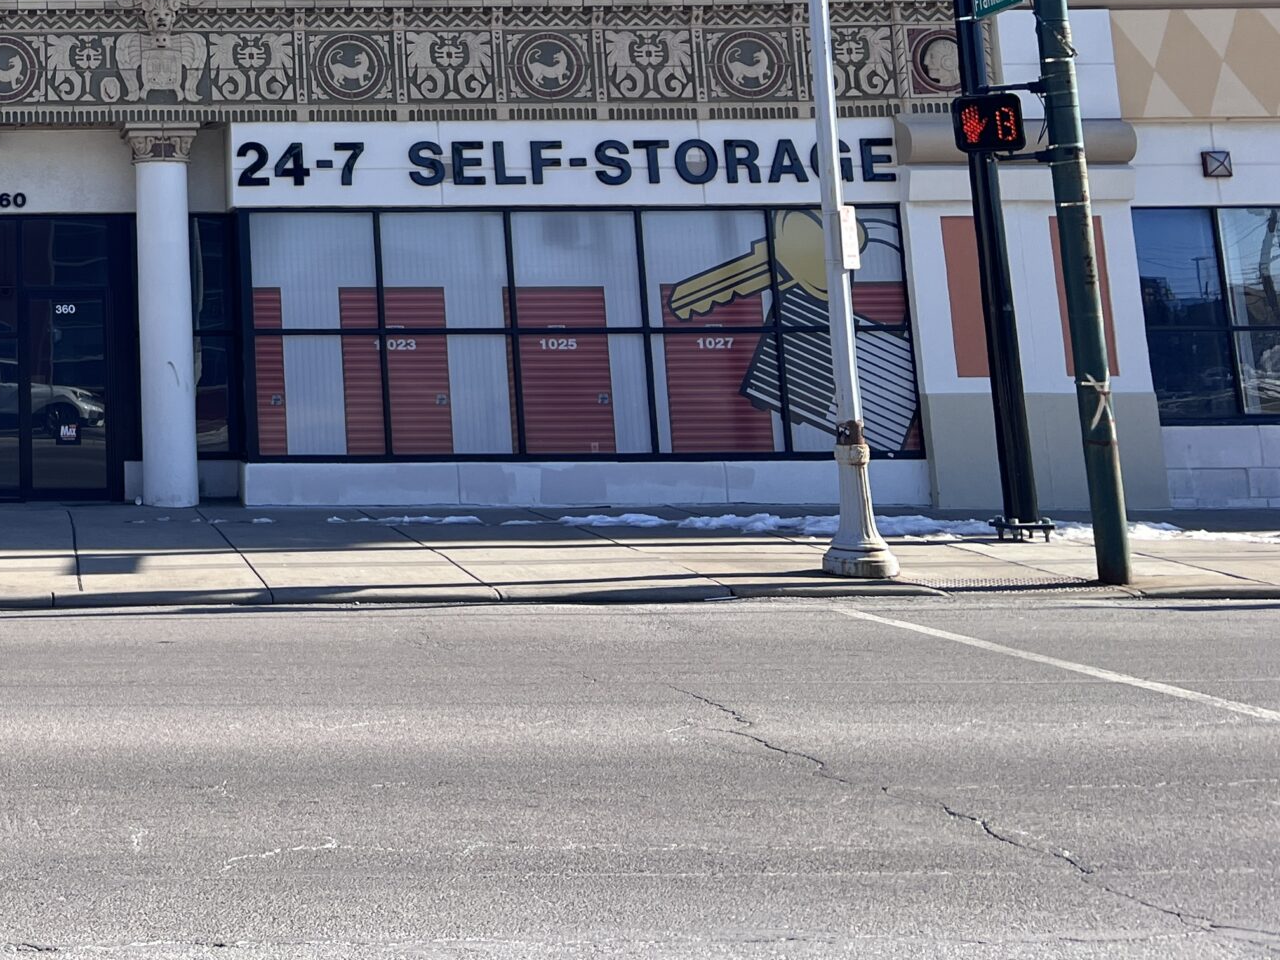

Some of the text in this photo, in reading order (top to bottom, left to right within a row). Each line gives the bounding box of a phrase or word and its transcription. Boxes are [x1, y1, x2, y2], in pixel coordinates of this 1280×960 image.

[995, 106, 1017, 141] 13
[236, 141, 365, 187] 24-7
[55, 304, 76, 314] 360
[373, 339, 417, 350] 1023
[540, 338, 577, 350] 1025
[697, 337, 734, 349] 1027
